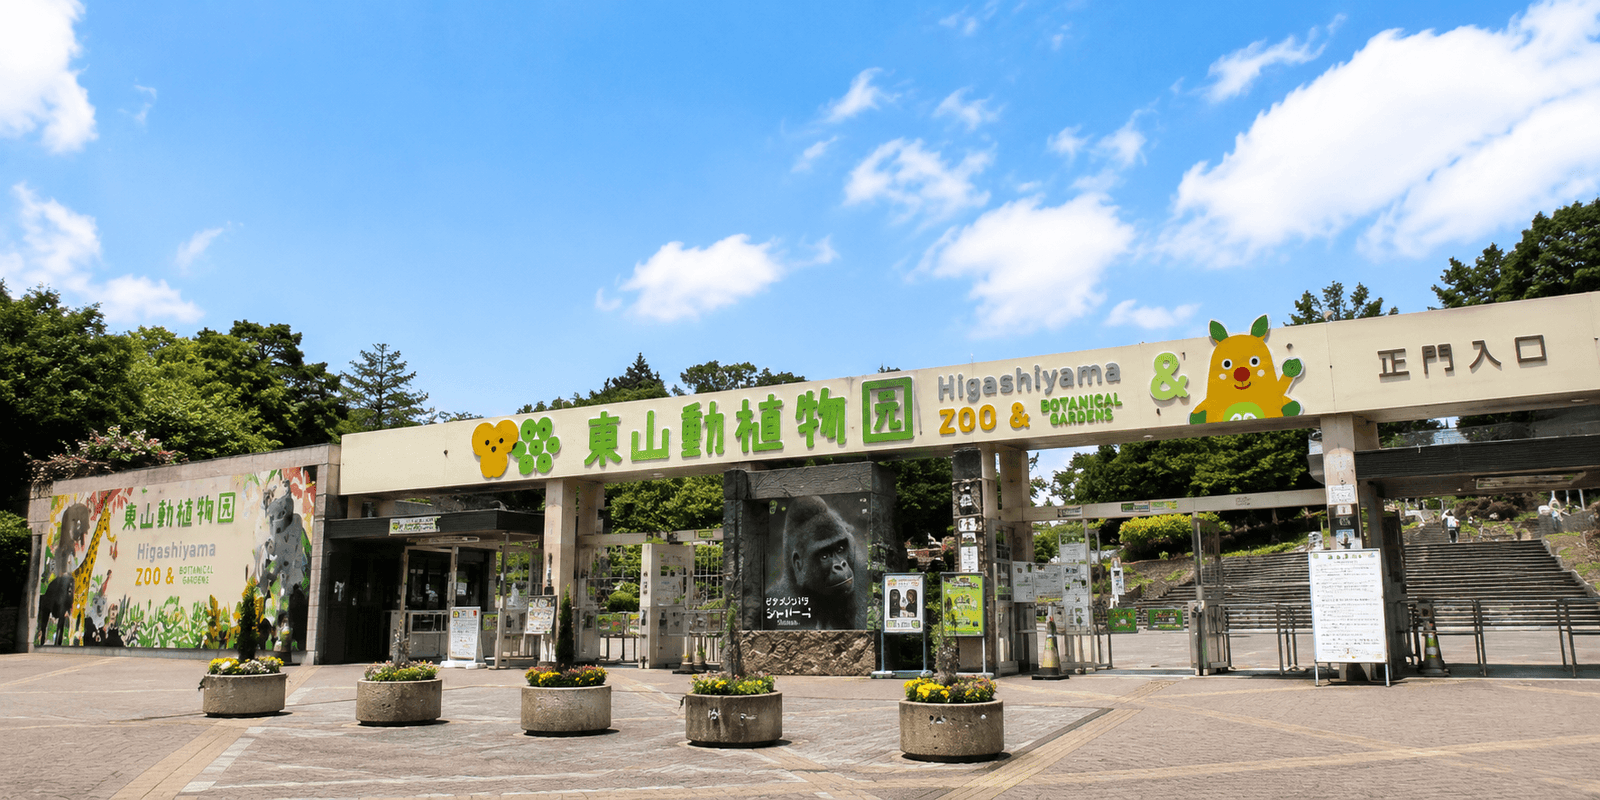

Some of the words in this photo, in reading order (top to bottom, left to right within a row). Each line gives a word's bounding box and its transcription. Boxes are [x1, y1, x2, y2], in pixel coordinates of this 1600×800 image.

[1377, 334, 1547, 377] 正門入口
[938, 362, 1121, 403] Higashiyama
[1040, 392, 1122, 413] BOTANICAL
[938, 404, 997, 435] ZOO
[1009, 402, 1030, 429] &
[1050, 407, 1114, 426] GARDENS
[137, 541, 216, 563] Higashiyama
[135, 566, 161, 586] ZOO
[165, 566, 175, 585] &
